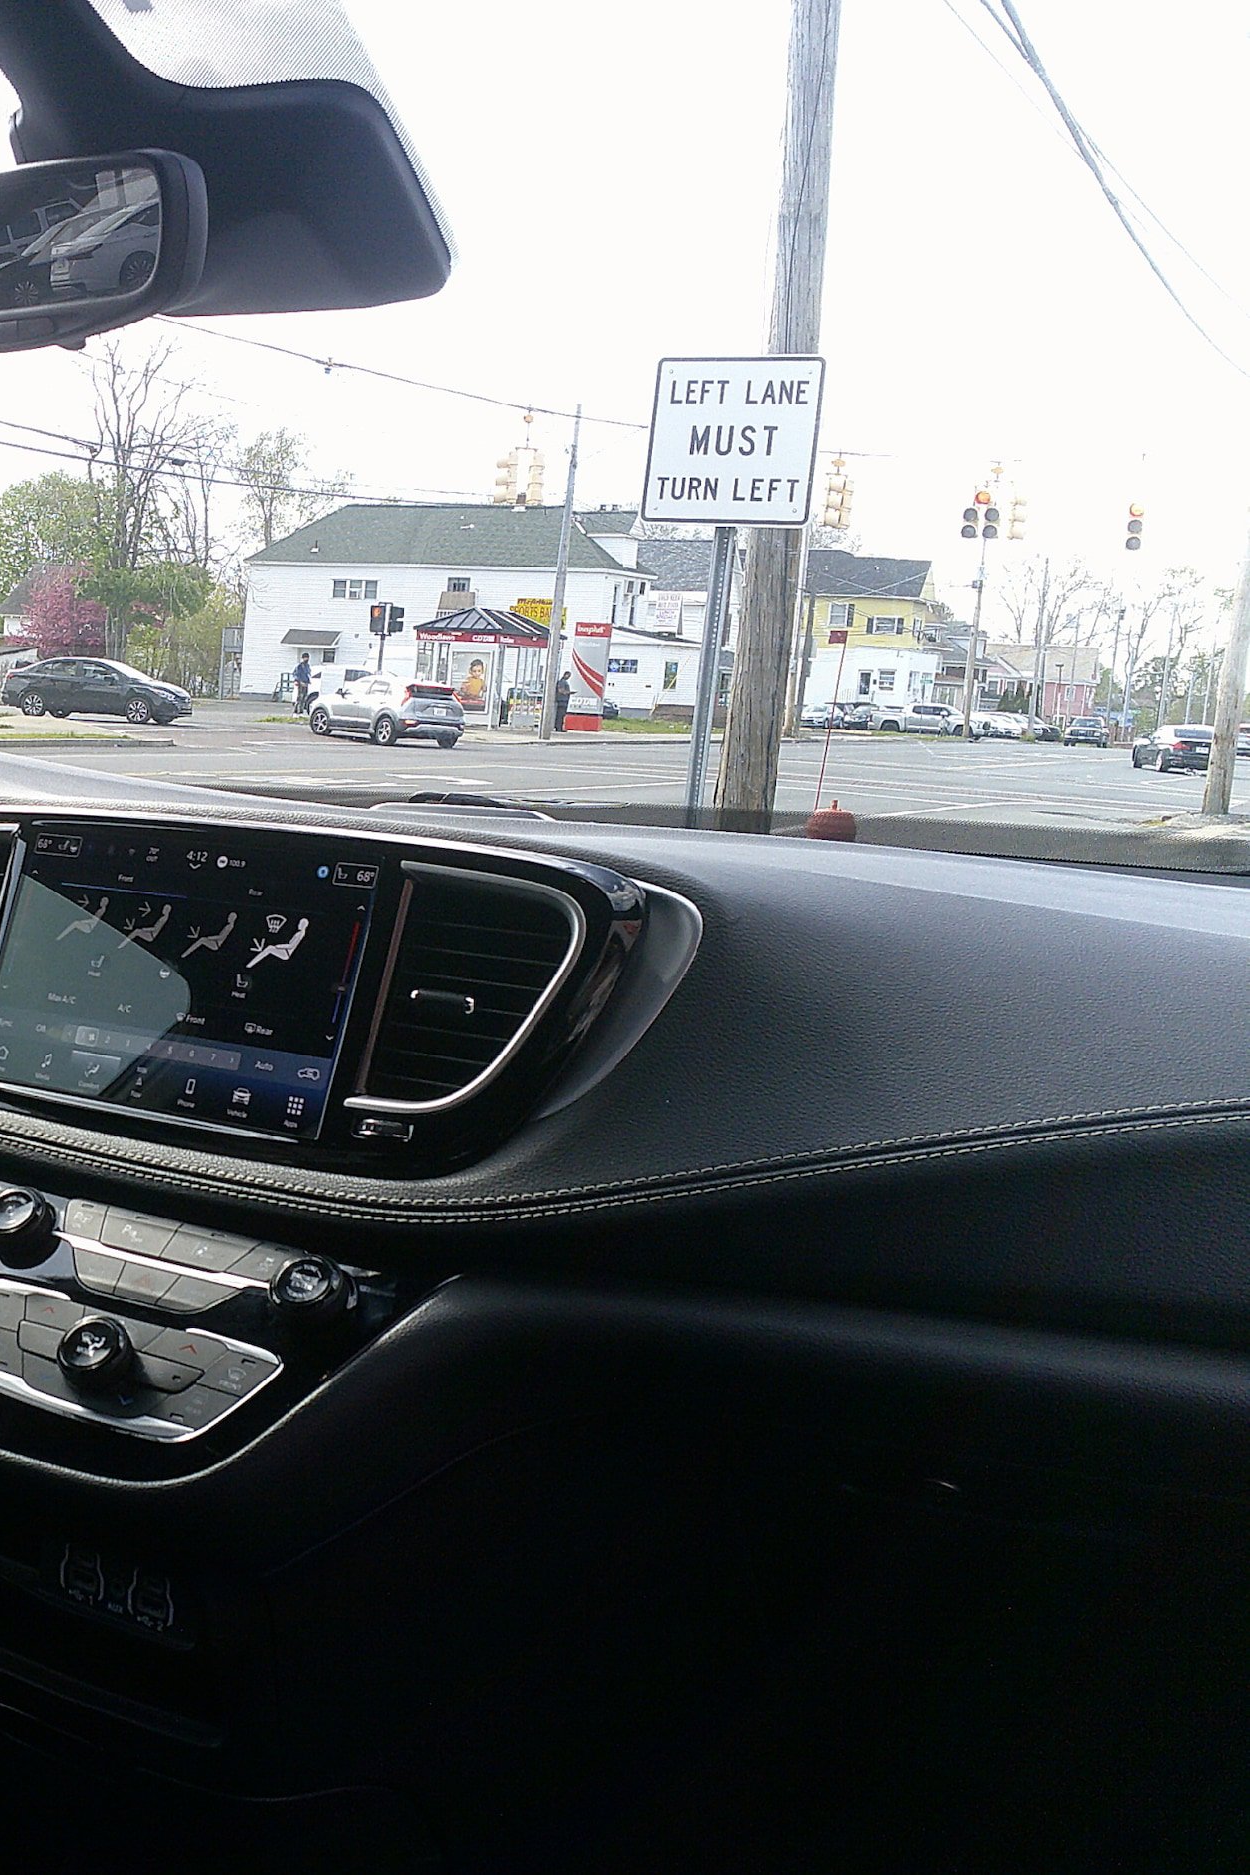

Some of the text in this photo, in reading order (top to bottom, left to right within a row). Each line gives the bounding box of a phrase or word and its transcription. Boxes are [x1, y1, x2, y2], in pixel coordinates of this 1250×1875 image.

[670, 380, 810, 405] LEFT LANE
[689, 425, 779, 456] MUST
[657, 477, 800, 503] TURN LEFT
[186, 851, 209, 863] 4:12
[117, 1003, 132, 1013] A/C
[186, 1014, 206, 1025] Front
[255, 1025, 274, 1036] Rear
[255, 1060, 274, 1071] Auto
[176, 1098, 195, 1108] Phone
[226, 1108, 248, 1119] Vehicle
[283, 1119, 298, 1129] Apps
